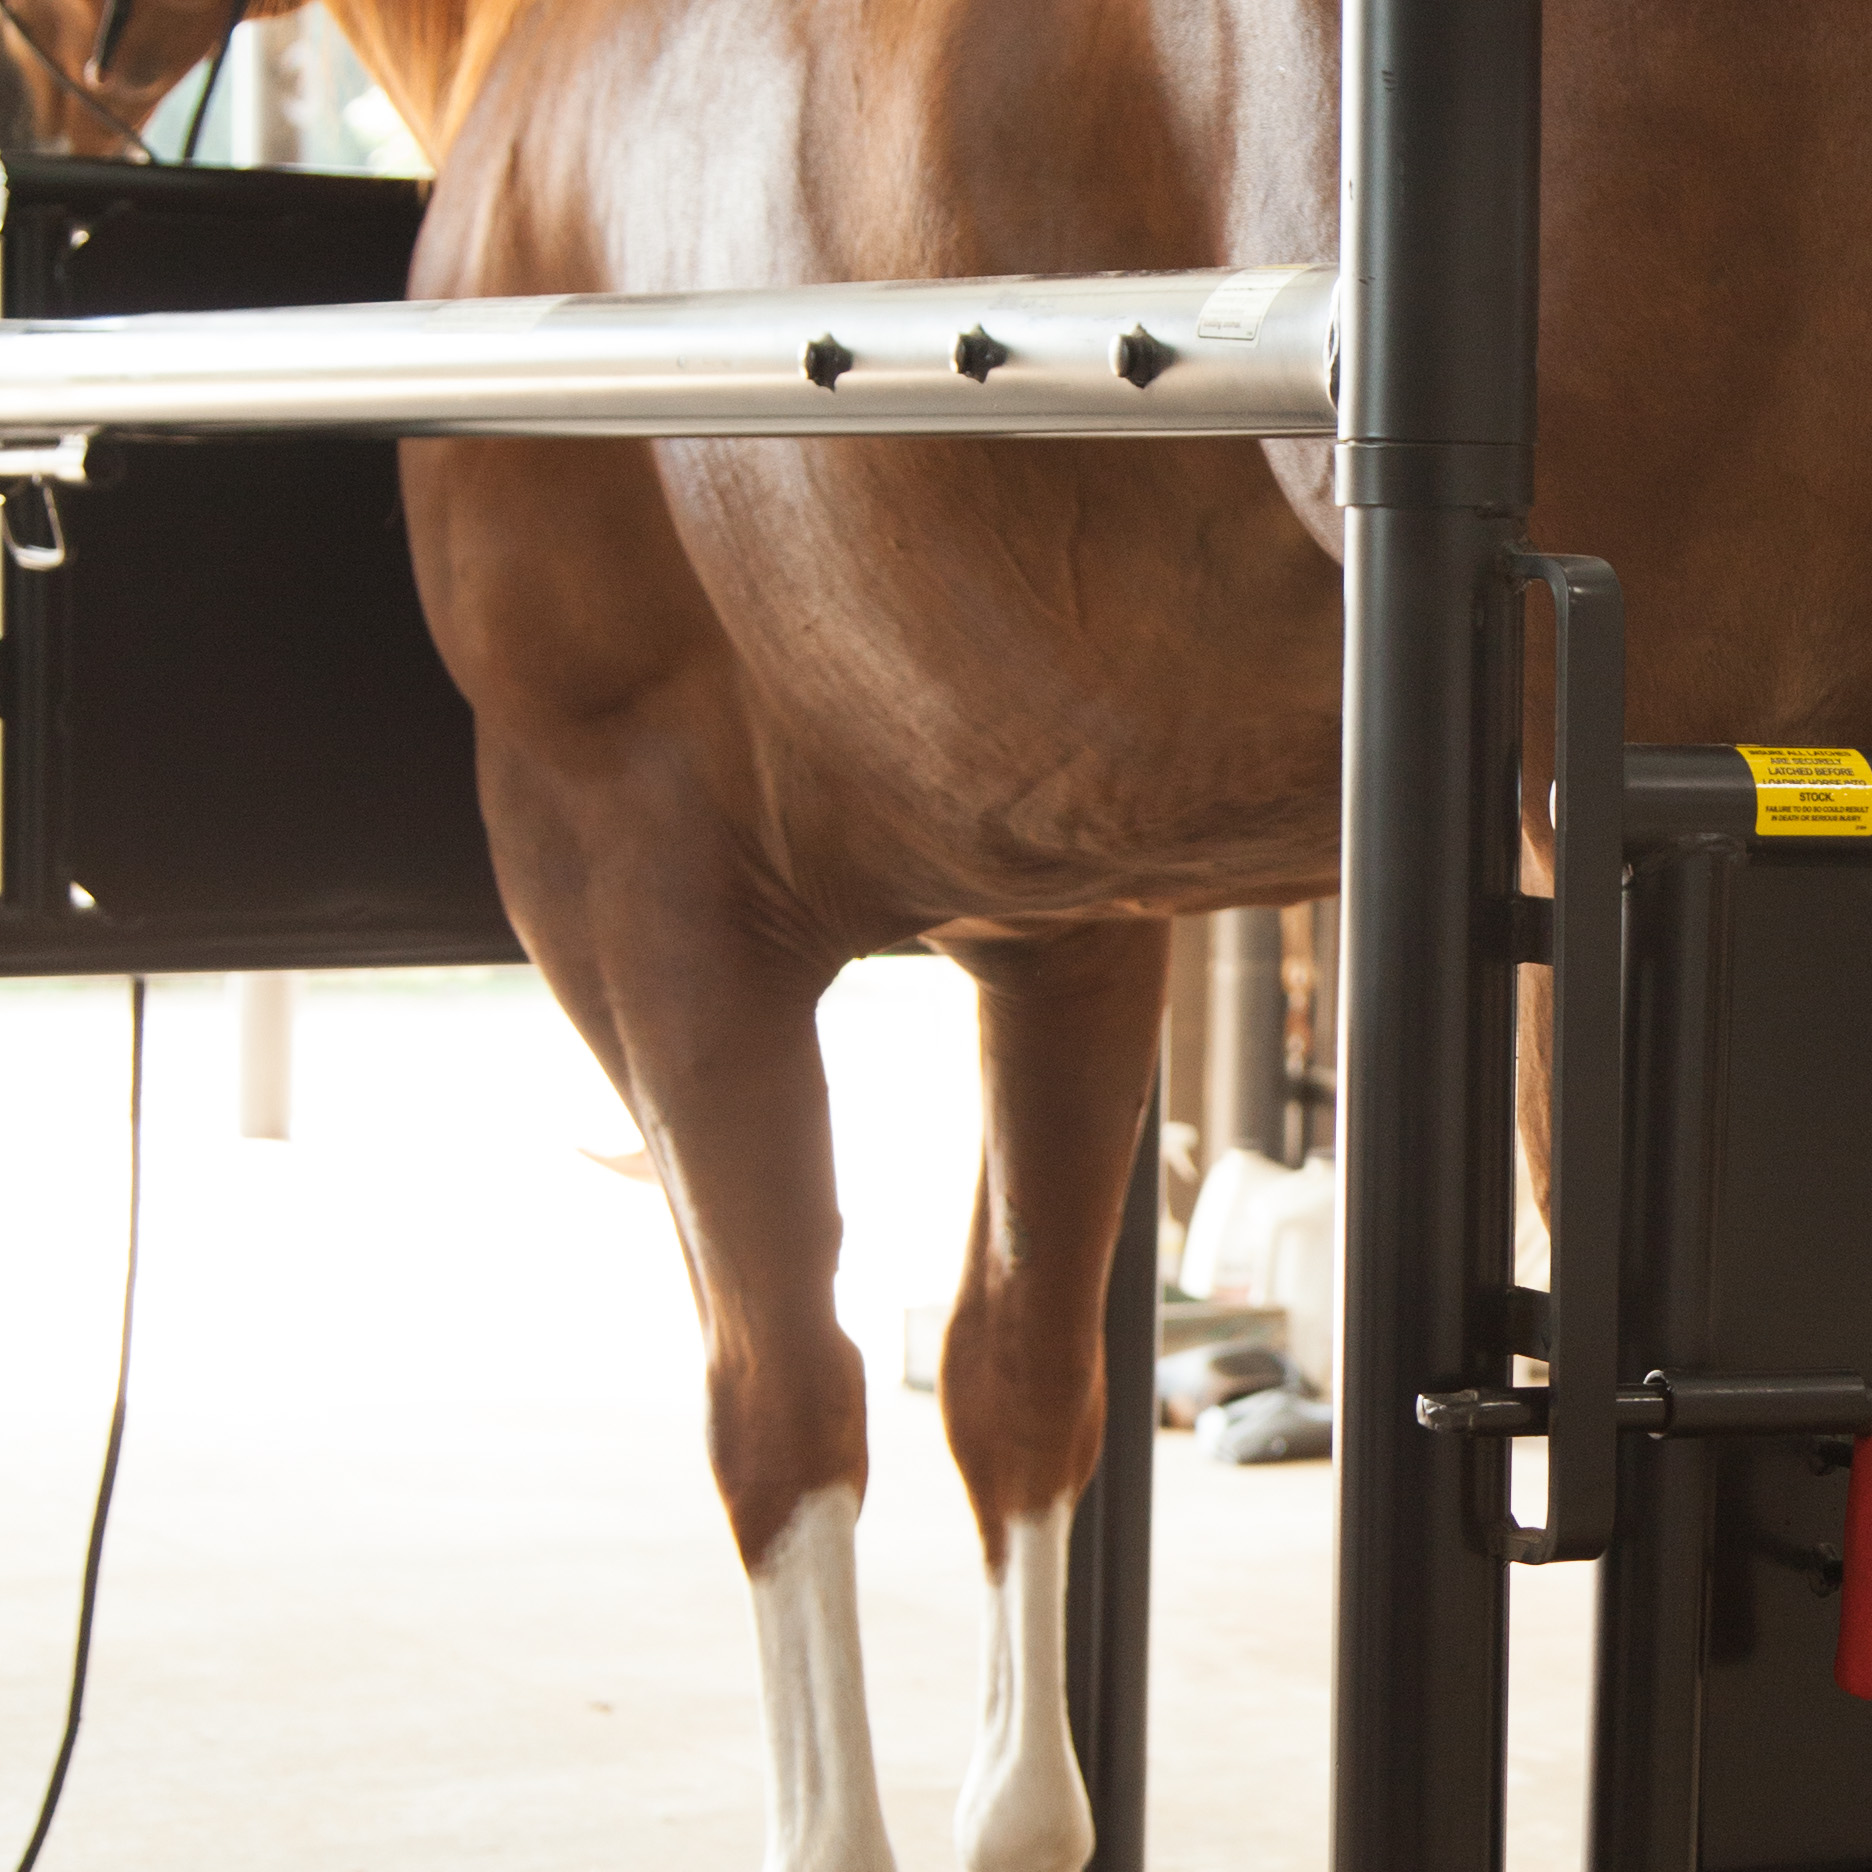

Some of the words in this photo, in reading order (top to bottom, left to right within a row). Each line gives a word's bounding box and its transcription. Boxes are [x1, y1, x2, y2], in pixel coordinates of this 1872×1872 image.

[1770, 757, 1790, 765] ARE
[1792, 757, 1842, 765] SECURELY
[1768, 767, 1813, 776] LATCHED
[1815, 767, 1855, 776] BEFORE
[1793, 805, 1802, 813] TO
